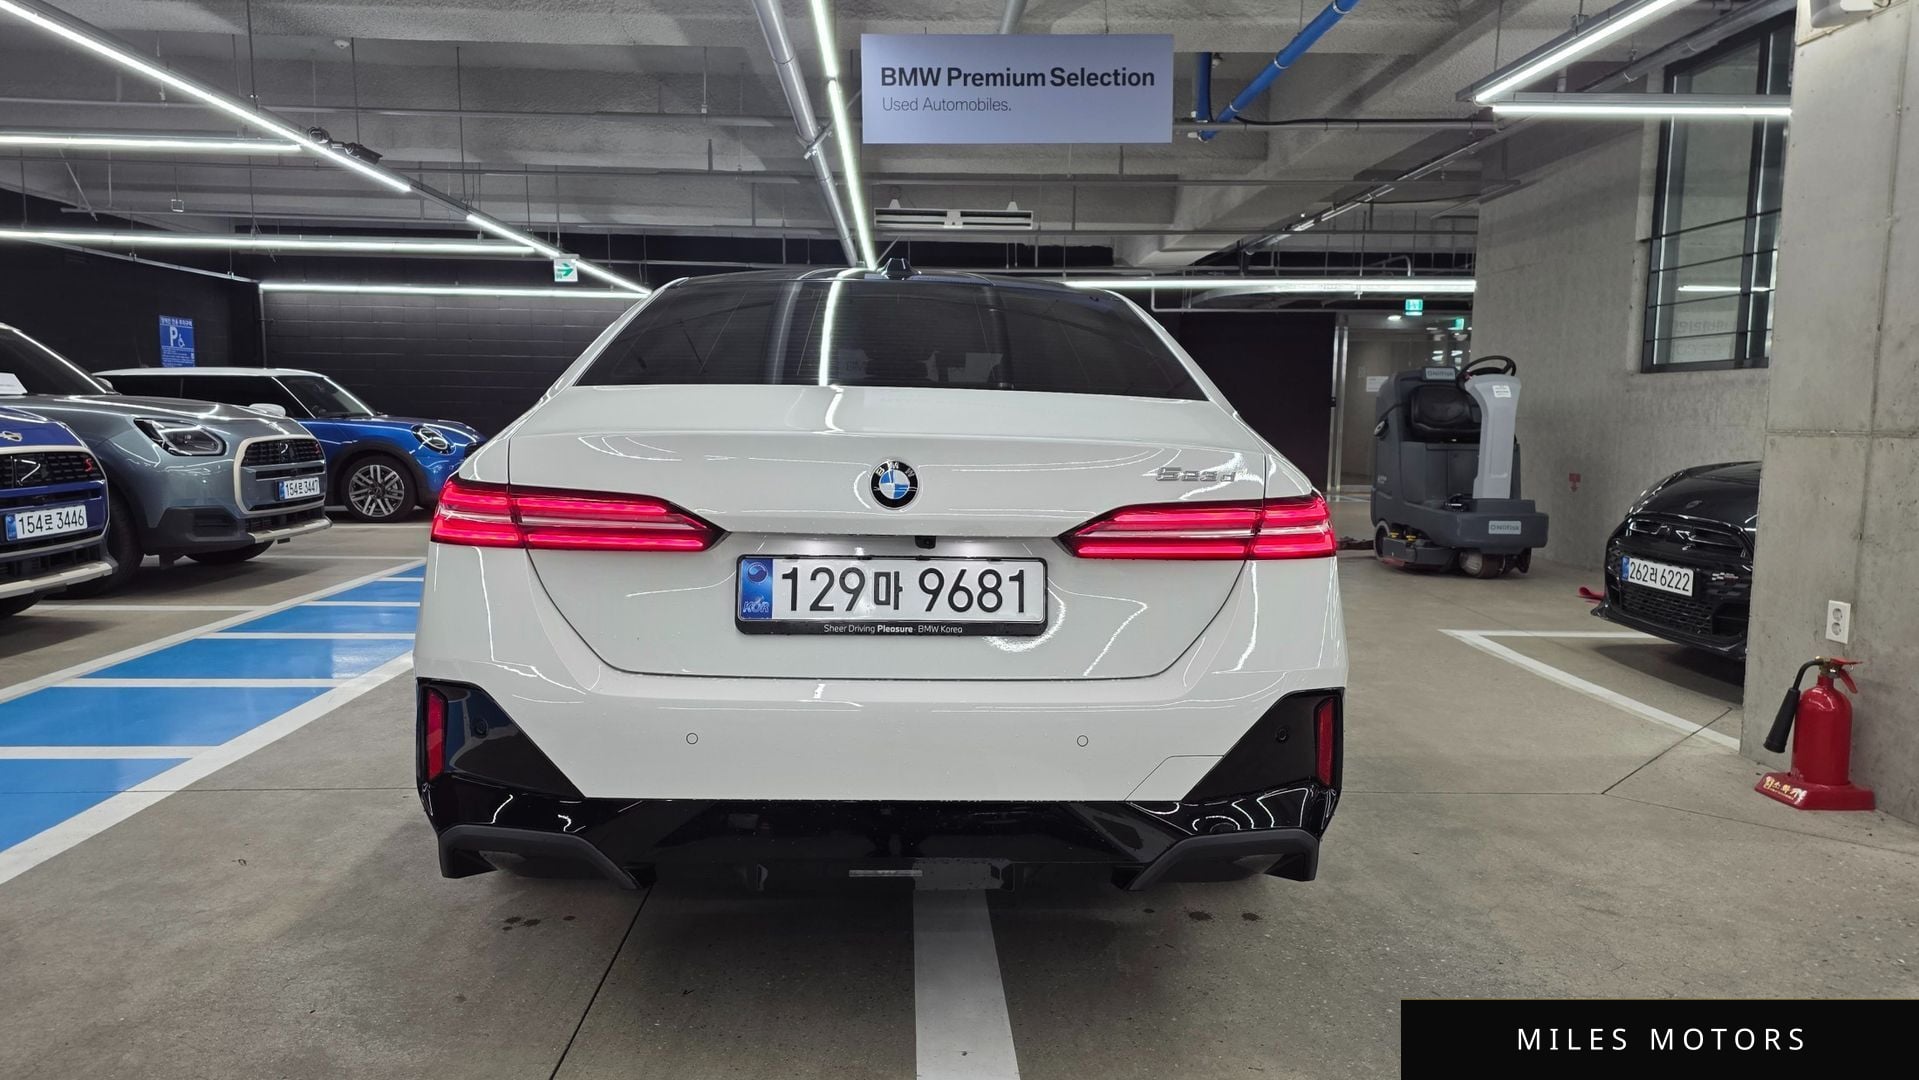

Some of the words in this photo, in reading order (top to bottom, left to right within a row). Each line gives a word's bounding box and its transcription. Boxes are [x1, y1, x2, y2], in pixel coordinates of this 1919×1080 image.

[881, 66, 941, 87] BMW
[947, 66, 1045, 87] Premium
[1049, 66, 1155, 87] Selection
[882, 96, 919, 112] Used
[922, 96, 1013, 112] Automobiles.
[875, 461, 915, 478] BMW
[1156, 467, 1236, 482] 523d
[18, 514, 54, 536] 154로
[56, 508, 85, 530] 3446
[781, 566, 903, 612] 129마
[918, 567, 1025, 613] 9681
[1659, 568, 1691, 592] 6222
[823, 624, 846, 633] Sheer
[848, 624, 875, 634] Driving
[877, 624, 913, 633] Pleasure
[918, 625, 939, 633] BMW
[940, 625, 963, 634] Korea
